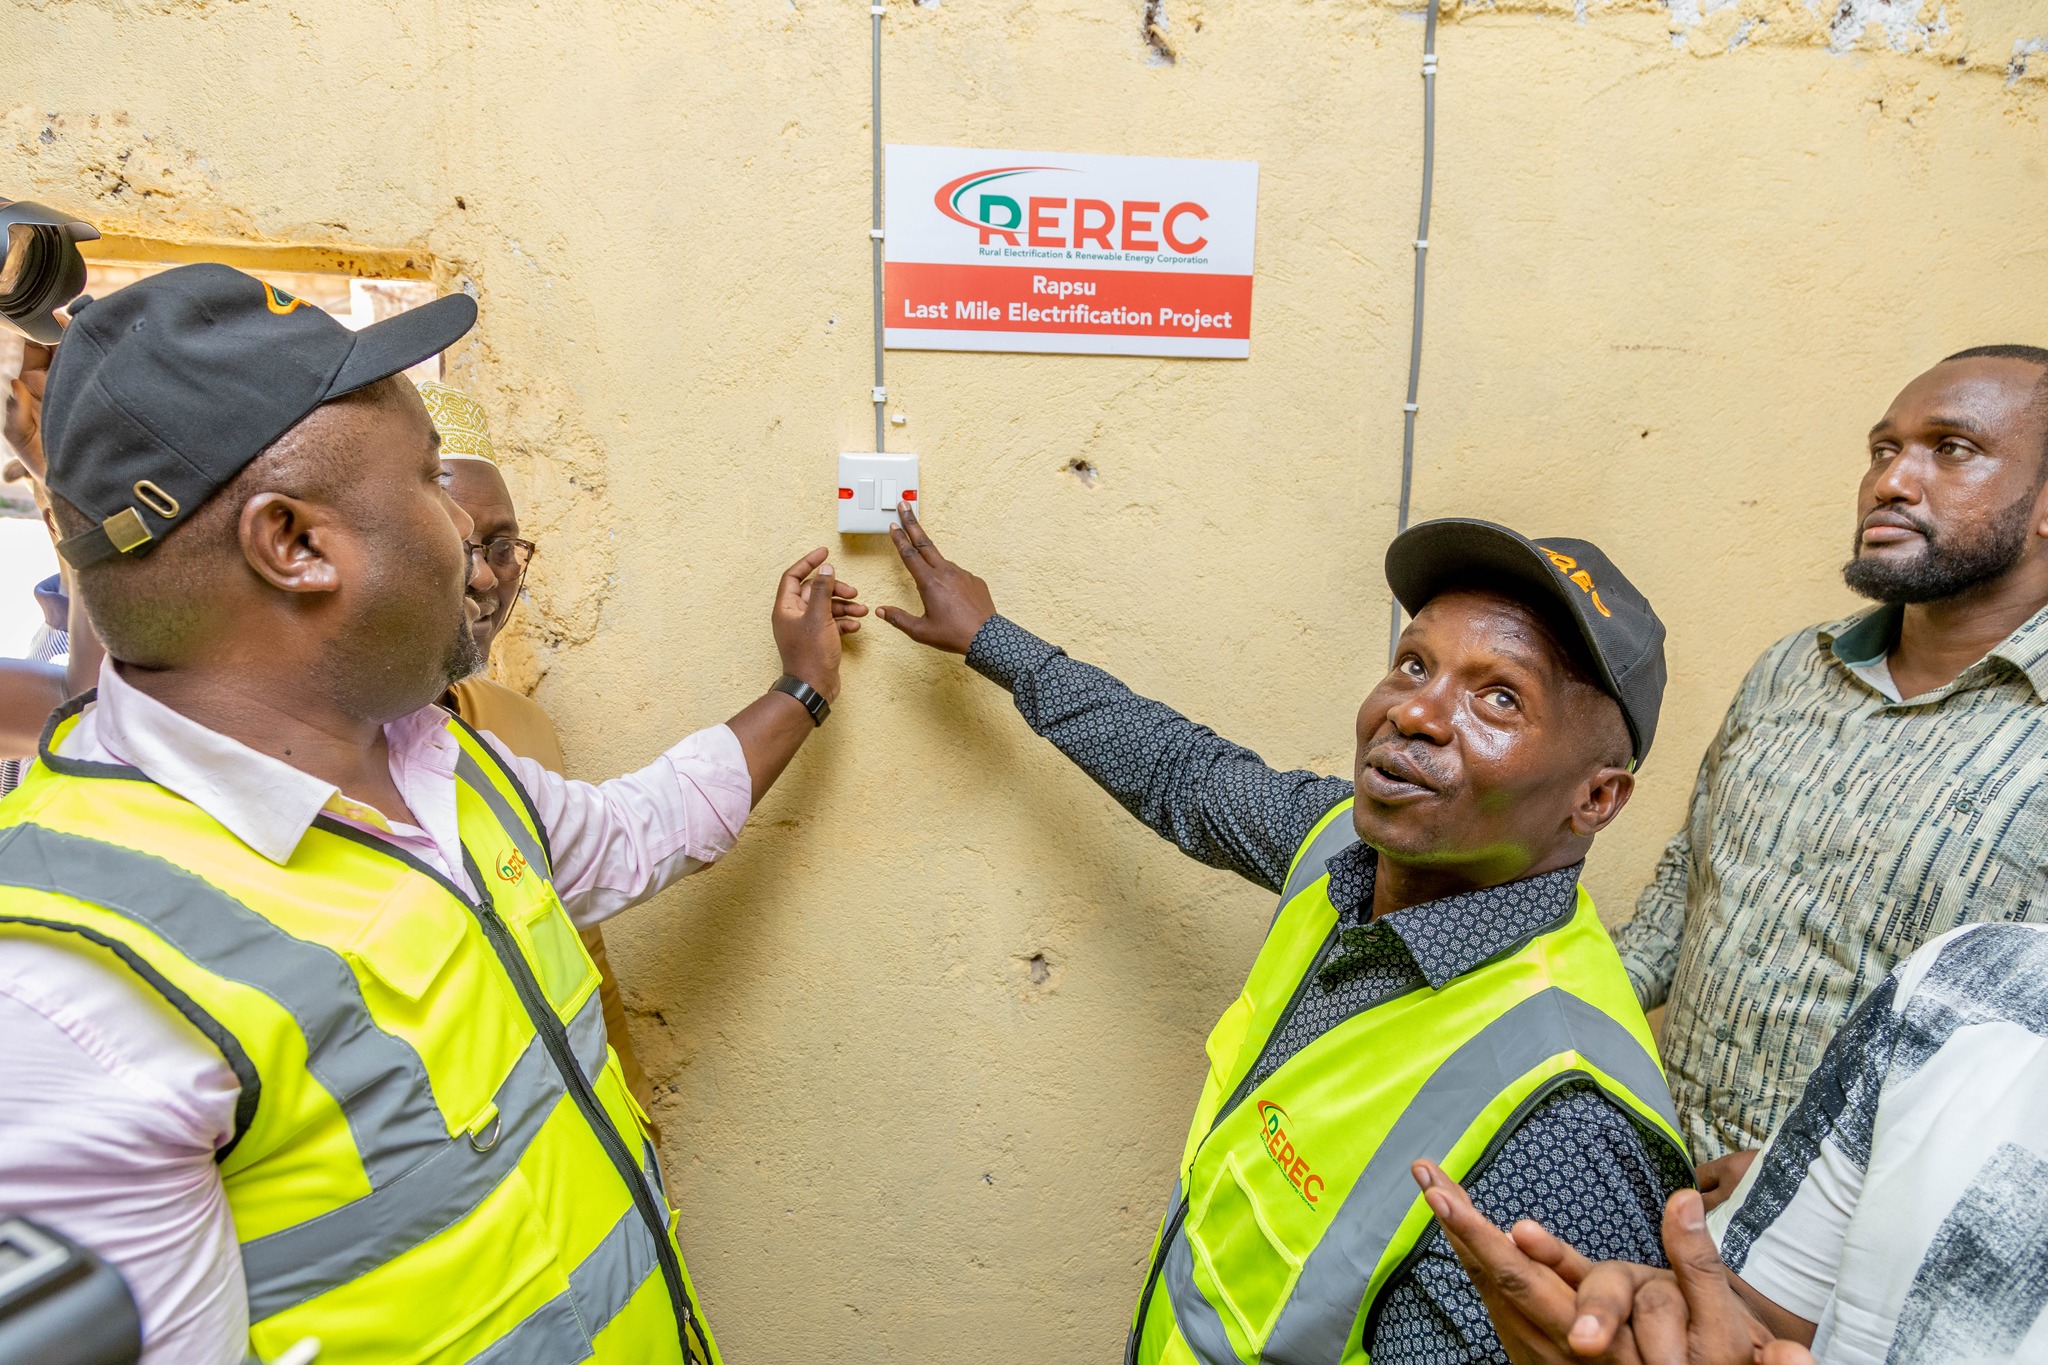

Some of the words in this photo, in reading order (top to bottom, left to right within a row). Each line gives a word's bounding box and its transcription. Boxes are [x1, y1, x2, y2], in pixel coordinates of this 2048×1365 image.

[979, 194, 1210, 255] REREC
[979, 247, 1001, 256] Rural
[1004, 248, 1063, 259] Electrification
[1066, 251, 1072, 259] &
[1075, 251, 1122, 261] Renewable
[1125, 253, 1154, 264] Energy
[1157, 254, 1208, 264] Corporation
[1033, 275, 1096, 300] Rapsu
[904, 299, 948, 319] Last
[955, 300, 1001, 321] Mile
[1008, 302, 1152, 325] Electrification
[1159, 307, 1232, 332] Project
[1262, 1113, 1325, 1203] REREC
